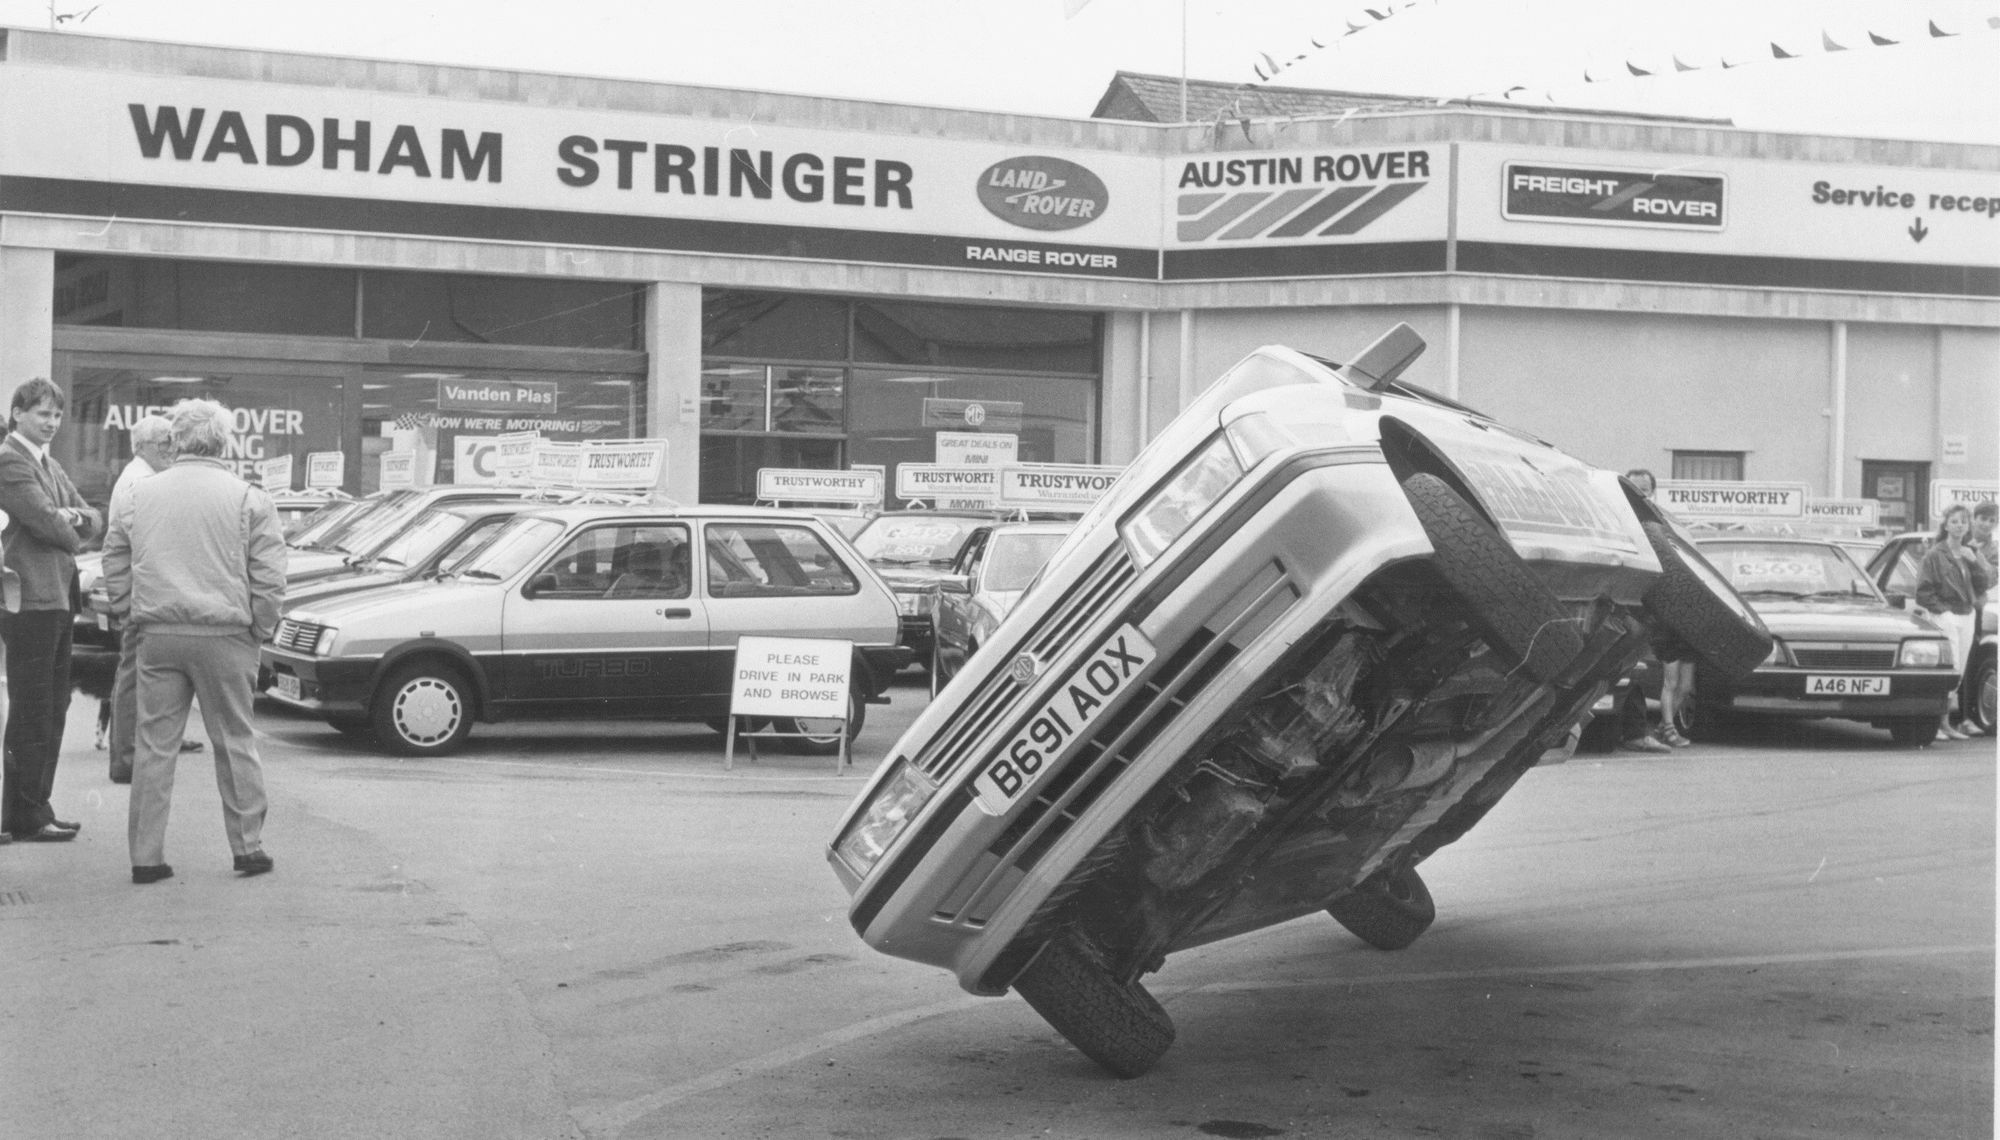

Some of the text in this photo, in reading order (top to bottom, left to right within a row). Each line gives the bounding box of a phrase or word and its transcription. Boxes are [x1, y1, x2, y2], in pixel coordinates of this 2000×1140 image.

[128, 103, 914, 210] WADHAM STRINGER
[1178, 150, 1430, 188] AUSTIN ROVER
[988, 167, 1048, 190] LAND
[1513, 174, 1619, 197] FREIGHT
[1022, 194, 1096, 219] ROVER
[1632, 197, 1718, 218] ROVER
[1812, 180, 2000, 219] Service recep
[966, 245, 1118, 269] RANGE ROVER
[445, 385, 553, 404] Vanden Plas
[231, 407, 304, 435] OVER
[429, 417, 461, 430] NOW
[464, 417, 503, 431] WE'RE
[506, 418, 581, 433] MOTORING!
[941, 439, 1013, 450] GREAT DEALS ON
[588, 452, 655, 469] TRUSTWORTHY
[965, 454, 989, 465] MINI
[773, 475, 866, 489] TRUSTWORTHY
[1038, 489, 1090, 499] Warranted
[1668, 489, 1790, 505] TRUSTWORTHY
[767, 653, 820, 666] PLEASE
[739, 669, 845, 684] DRIVE IN PARK
[1814, 678, 1883, 693] A46 NFJ
[743, 687, 840, 701] AND BROWSE
[987, 635, 1145, 799] B691 AOX
